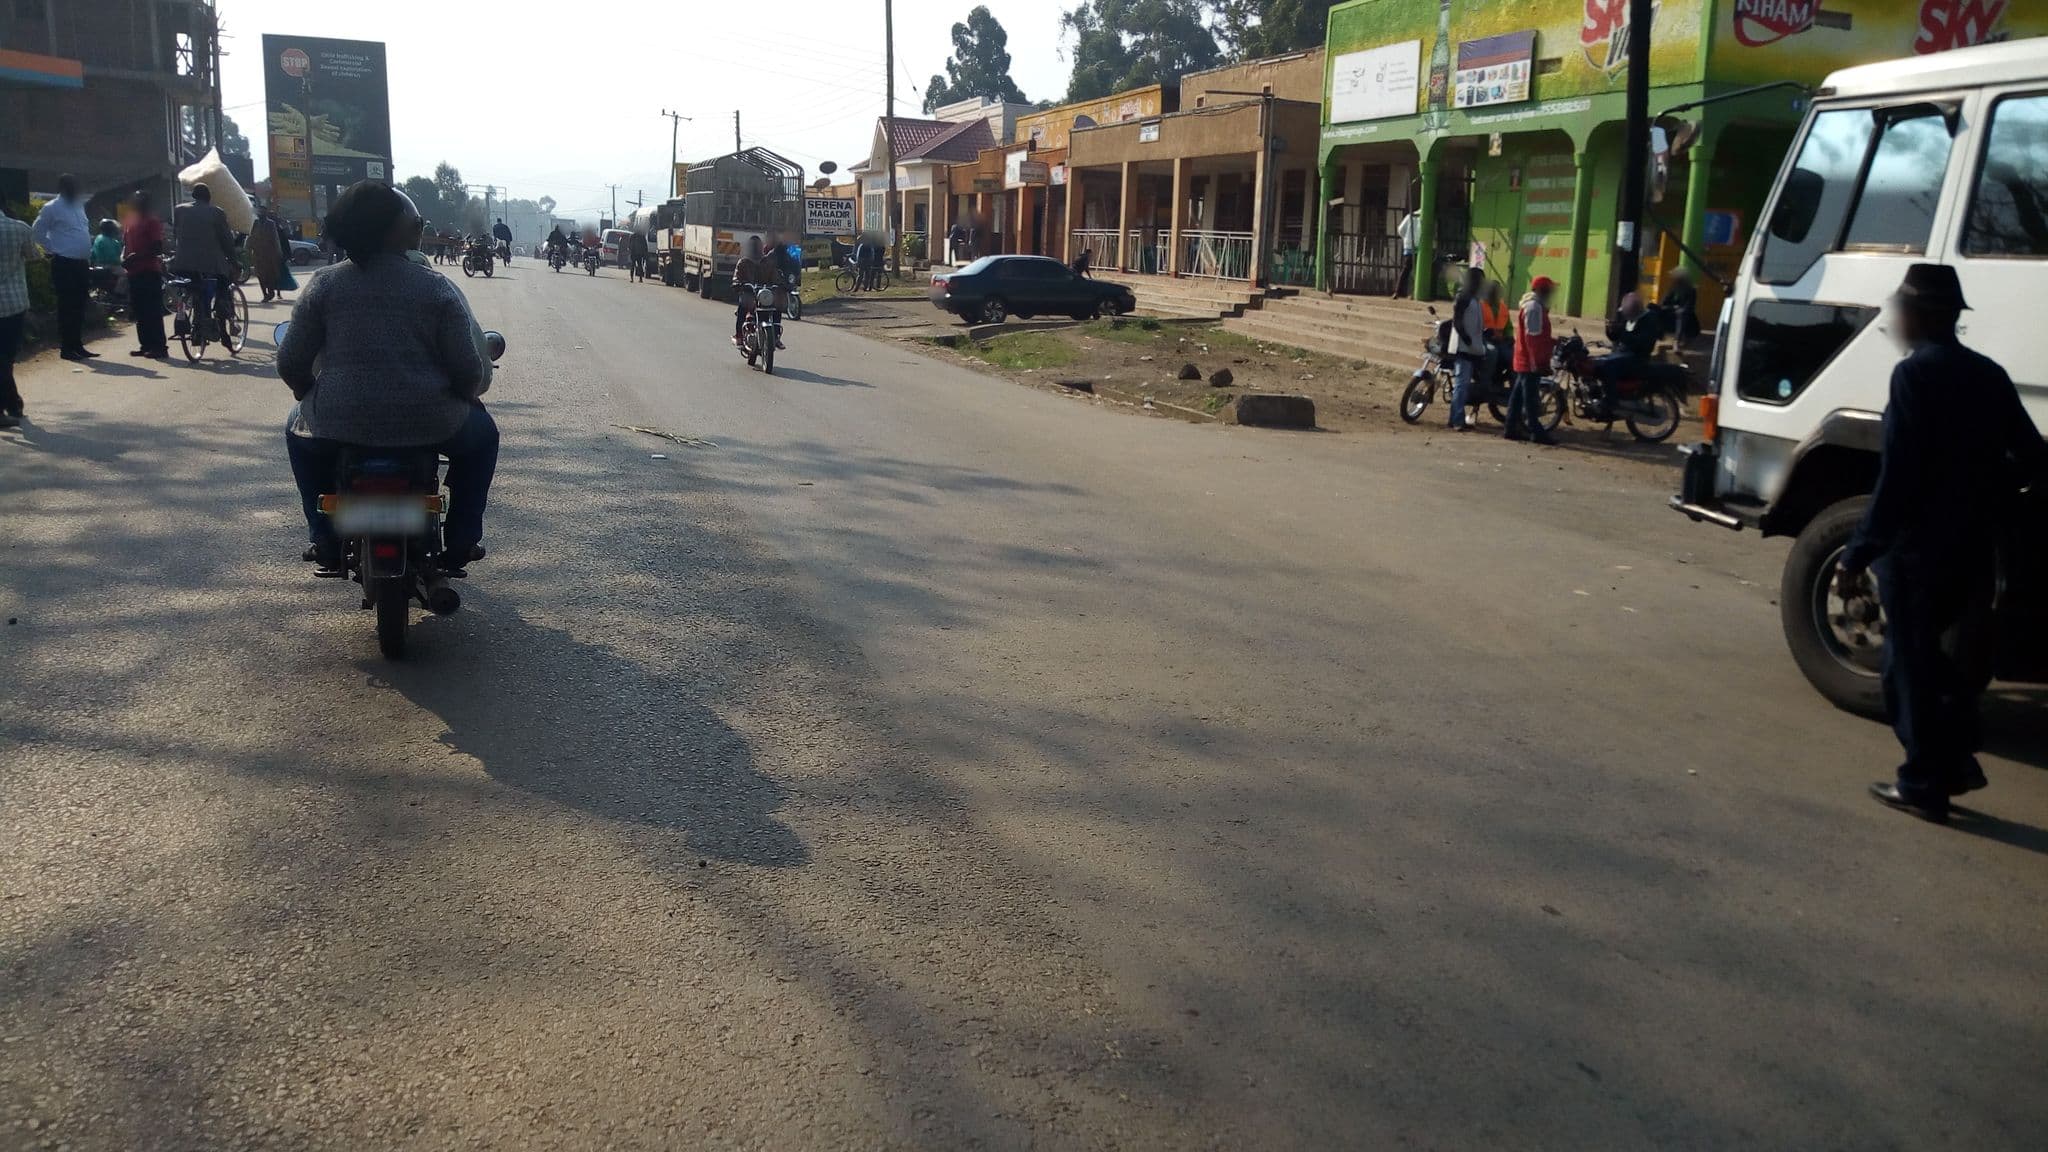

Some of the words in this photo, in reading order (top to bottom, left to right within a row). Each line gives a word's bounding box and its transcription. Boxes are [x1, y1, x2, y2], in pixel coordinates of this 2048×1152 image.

[1581, 0, 1629, 43] SK
[1914, 0, 2004, 54] SKY
[282, 56, 308, 68] STOP
[807, 200, 853, 210] SERENA
[809, 209, 850, 218] MAGADIR
[807, 218, 842, 227] RESTAURANT
